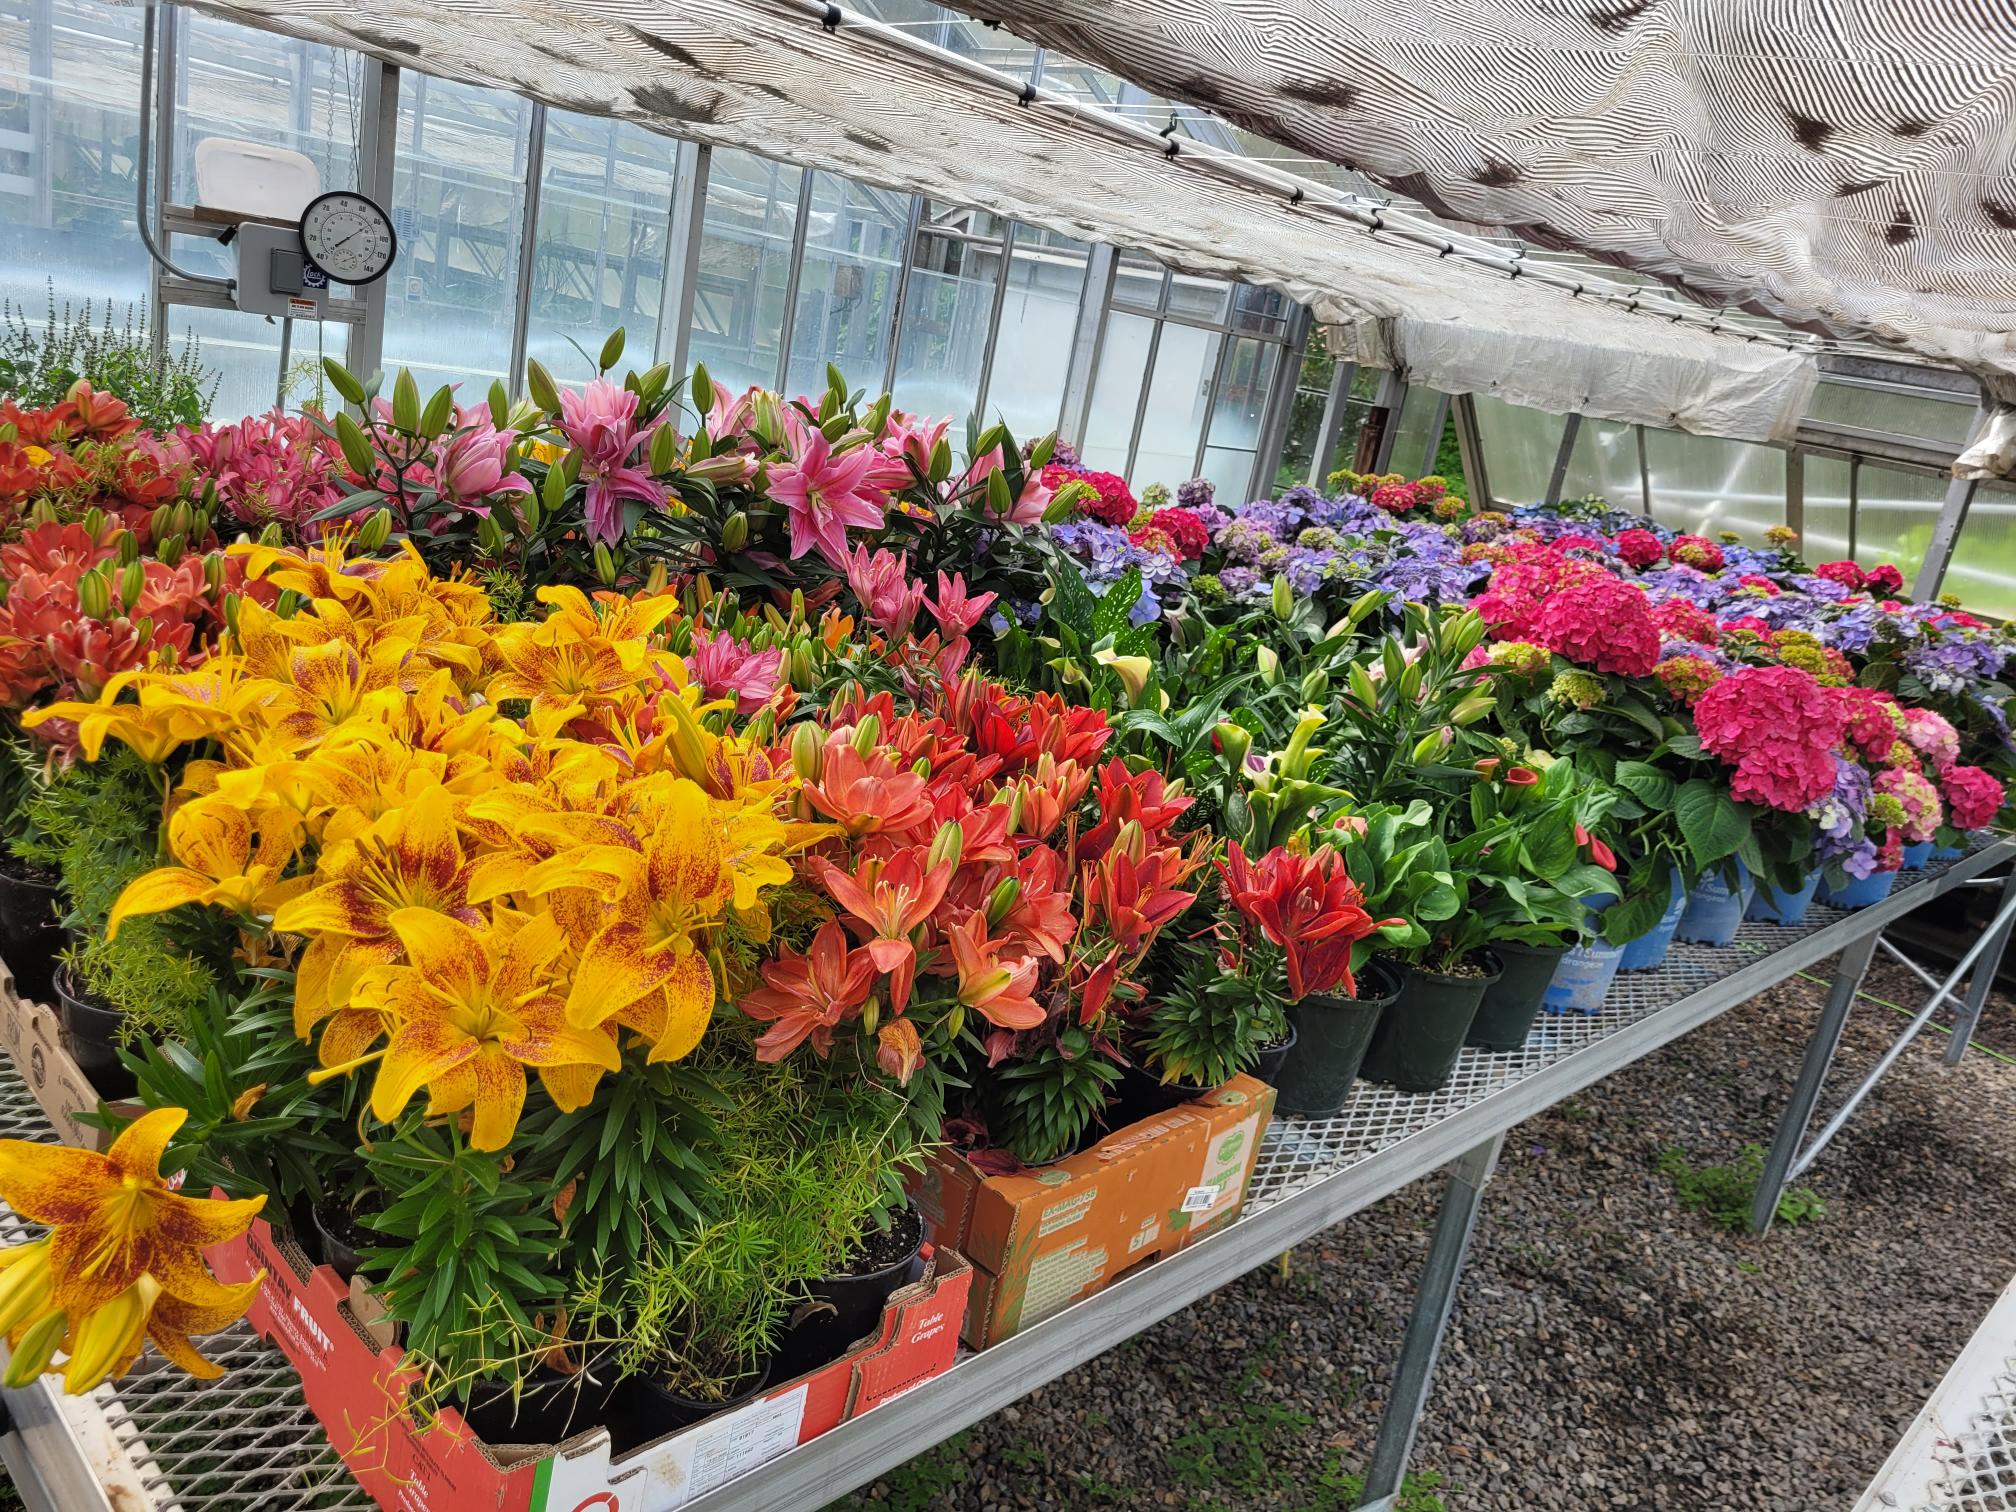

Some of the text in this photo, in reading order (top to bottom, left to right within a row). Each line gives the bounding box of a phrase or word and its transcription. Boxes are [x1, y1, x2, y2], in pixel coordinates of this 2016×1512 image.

[379, 235, 389, 244] 100
[363, 264, 374, 273] 140
[246, 1231, 292, 1300] QUINTAY
[919, 1311, 944, 1330] Table
[911, 1323, 945, 1344] Grapes
